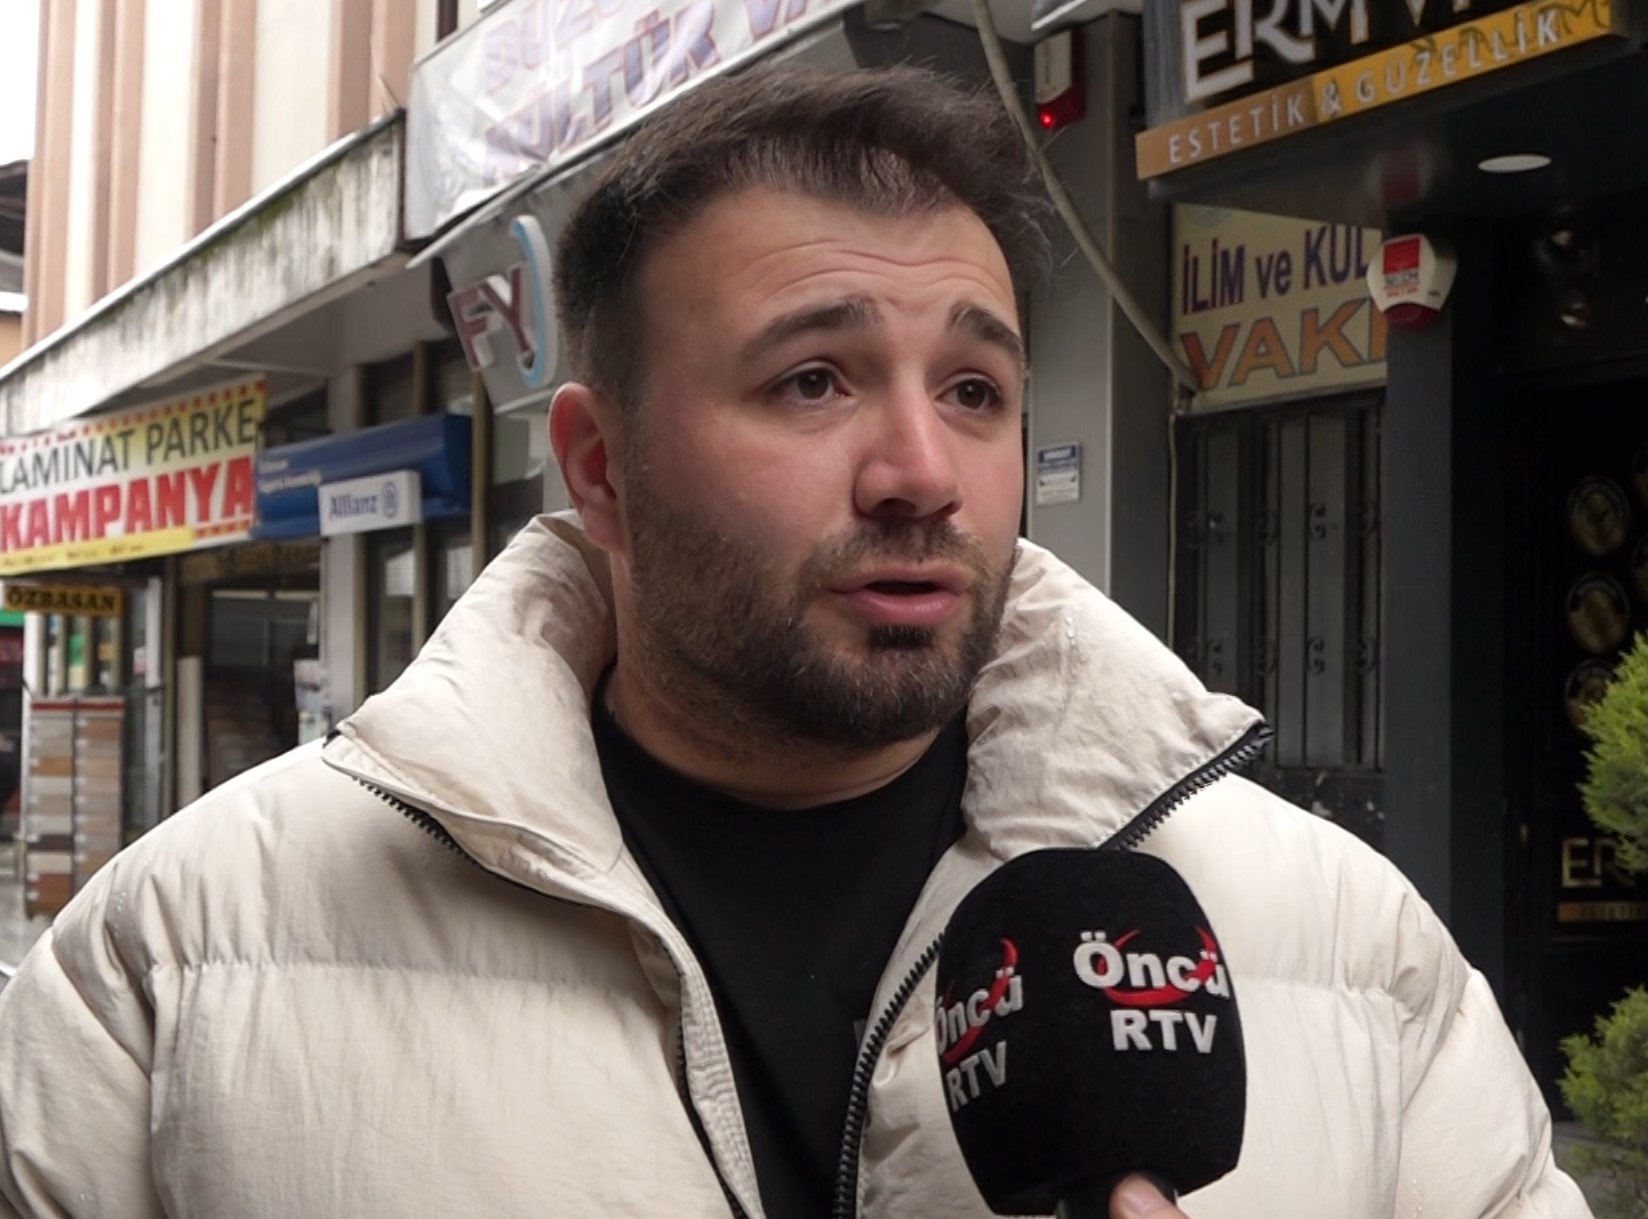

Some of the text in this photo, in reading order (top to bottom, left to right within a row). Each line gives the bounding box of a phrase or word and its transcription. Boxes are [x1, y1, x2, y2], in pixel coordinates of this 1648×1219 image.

[1168, 94, 1305, 164] ESTETİK
[1321, 77, 1343, 117] &
[1181, 236, 1245, 315] İLİM
[1256, 249, 1292, 299] ve
[0, 399, 255, 494] LAMINAT PARKE
[0, 455, 254, 554] KAMPANYA
[329, 494, 378, 519] Allianz
[1073, 929, 1231, 1000] Öncü
[1110, 1008, 1218, 1055] RTV
[946, 1040, 1008, 1113] RTV
